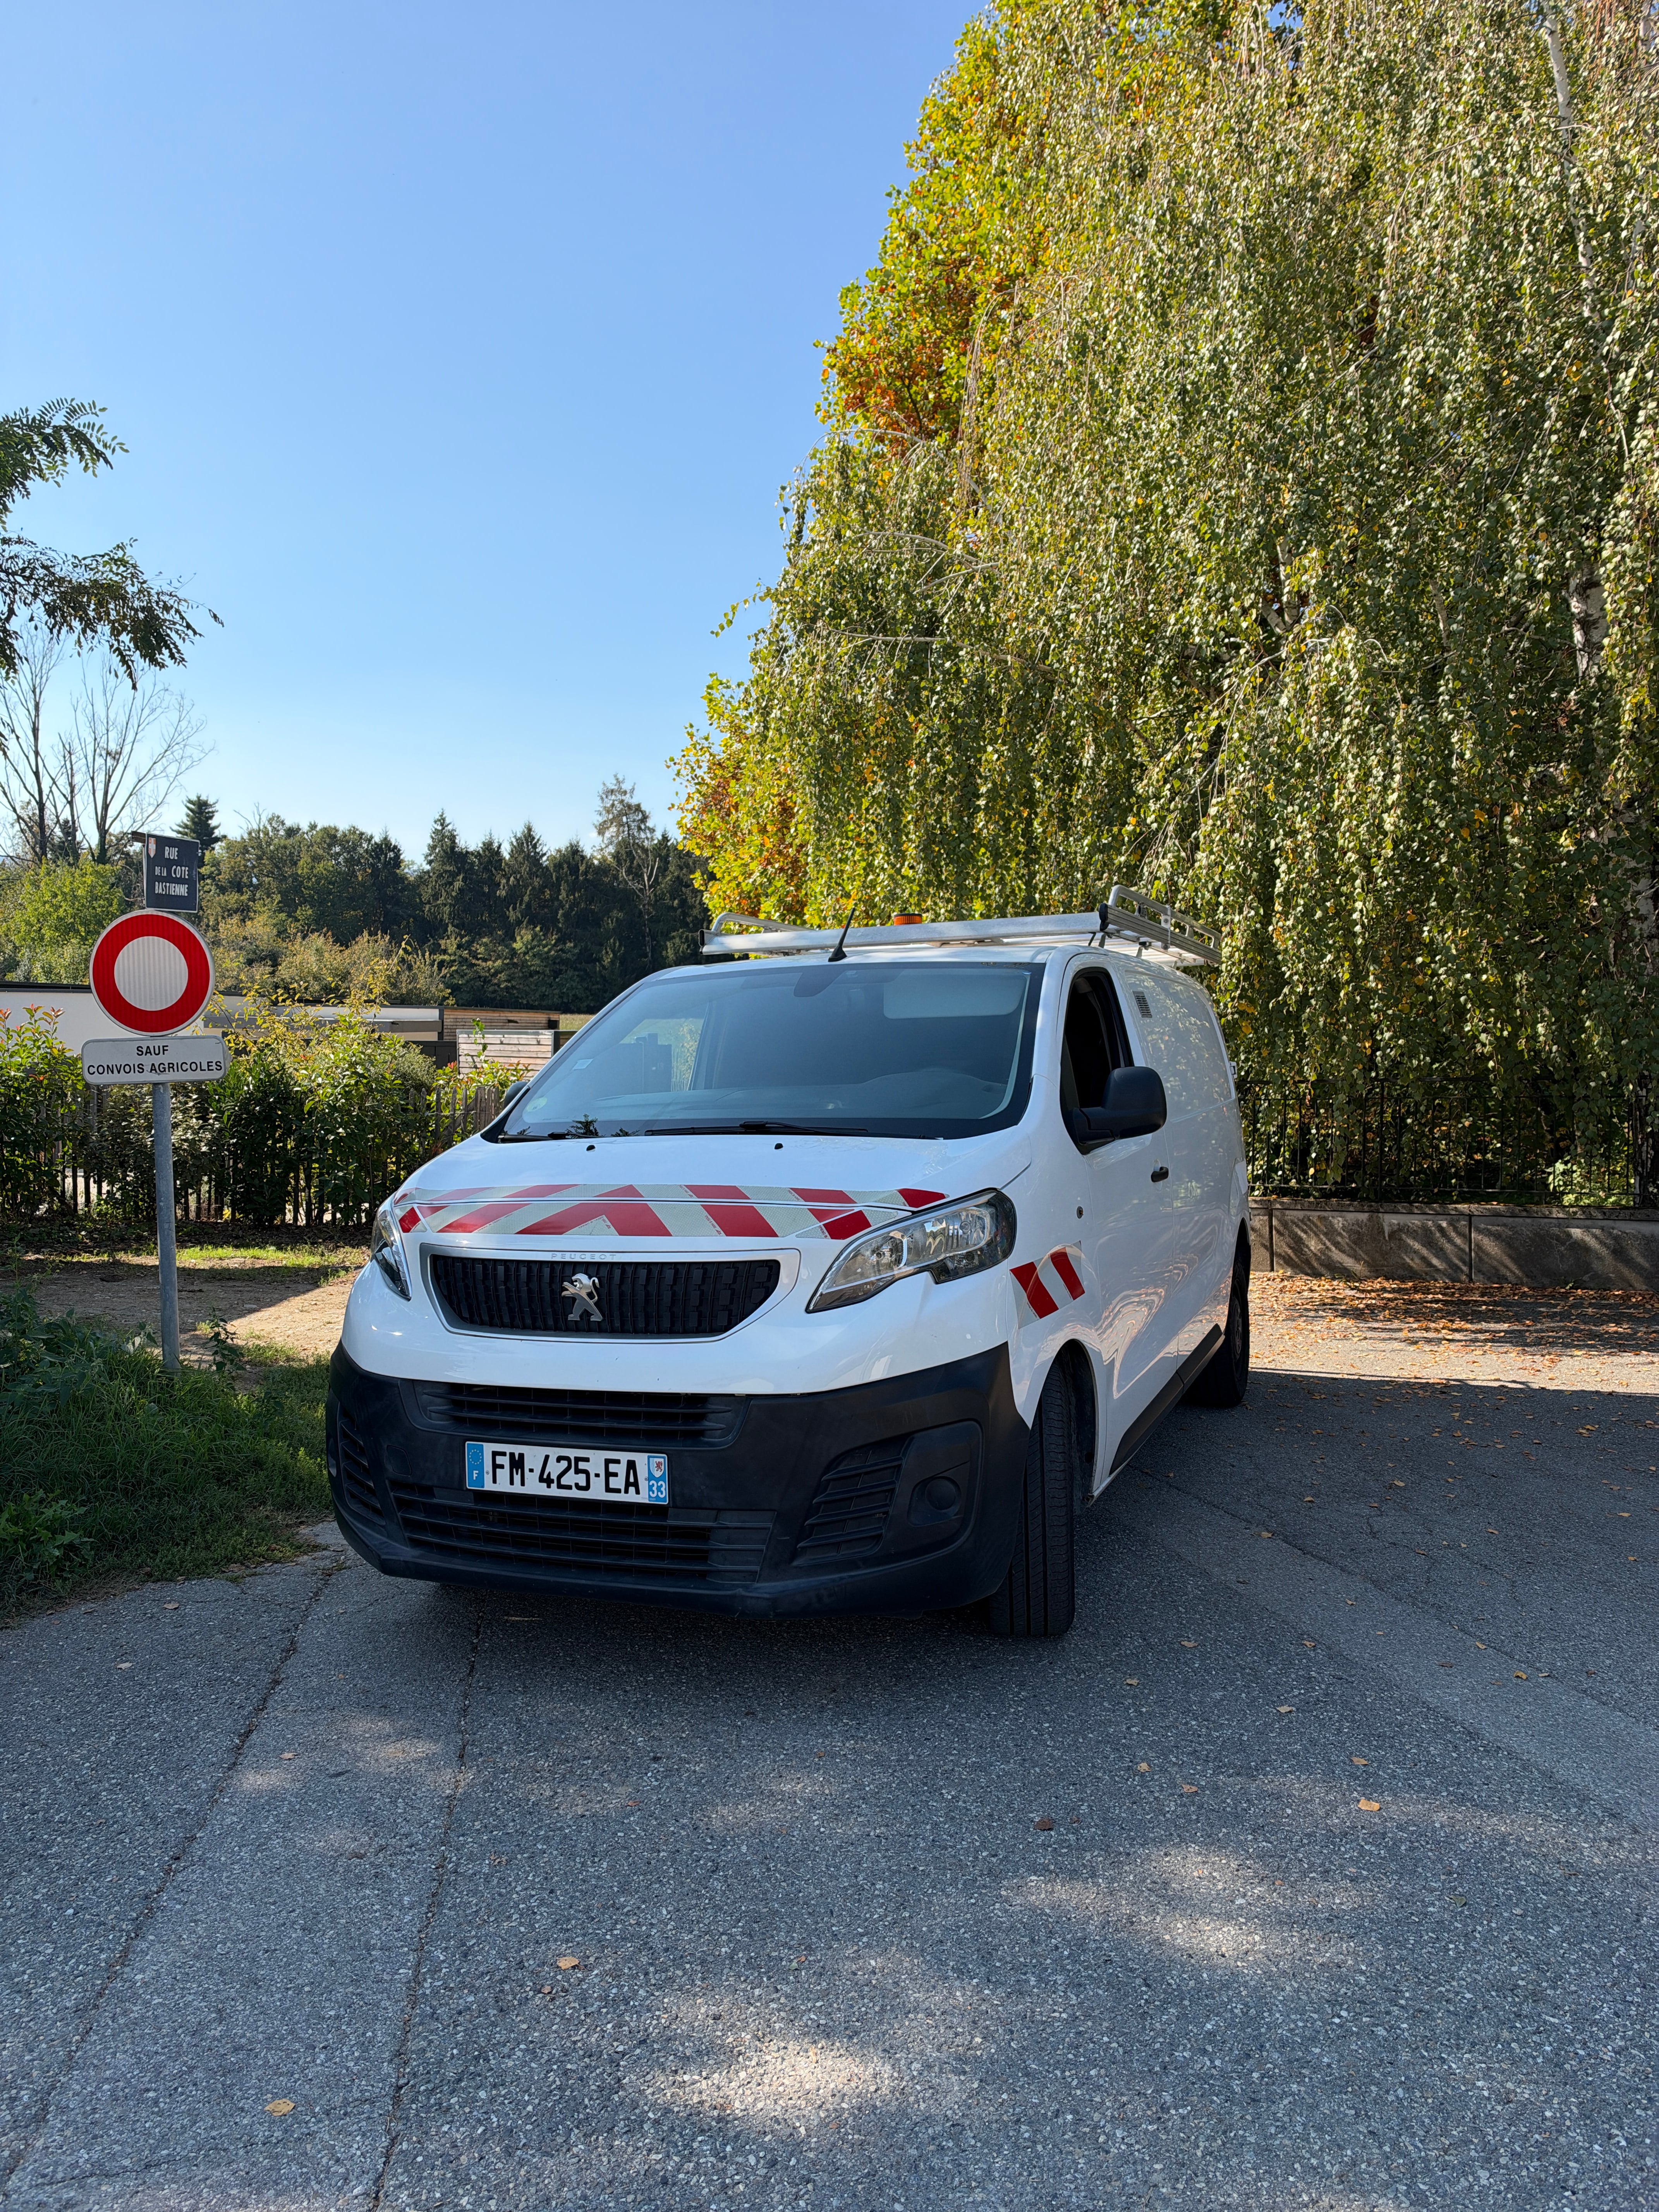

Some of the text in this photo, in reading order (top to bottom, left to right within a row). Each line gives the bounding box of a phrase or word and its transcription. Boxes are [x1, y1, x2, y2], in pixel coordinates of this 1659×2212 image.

[165, 847, 178, 859] RUE
[155, 865, 189, 878] DE LA COTE
[155, 881, 188, 896] BASTIENNE
[136, 1045, 168, 1056] SAUF
[88, 1061, 222, 1075] CONVOIS AGRICOLES
[473, 1470, 479, 1480] F
[491, 1450, 641, 1495] FM-425-EA
[649, 1480, 666, 1498] 33
